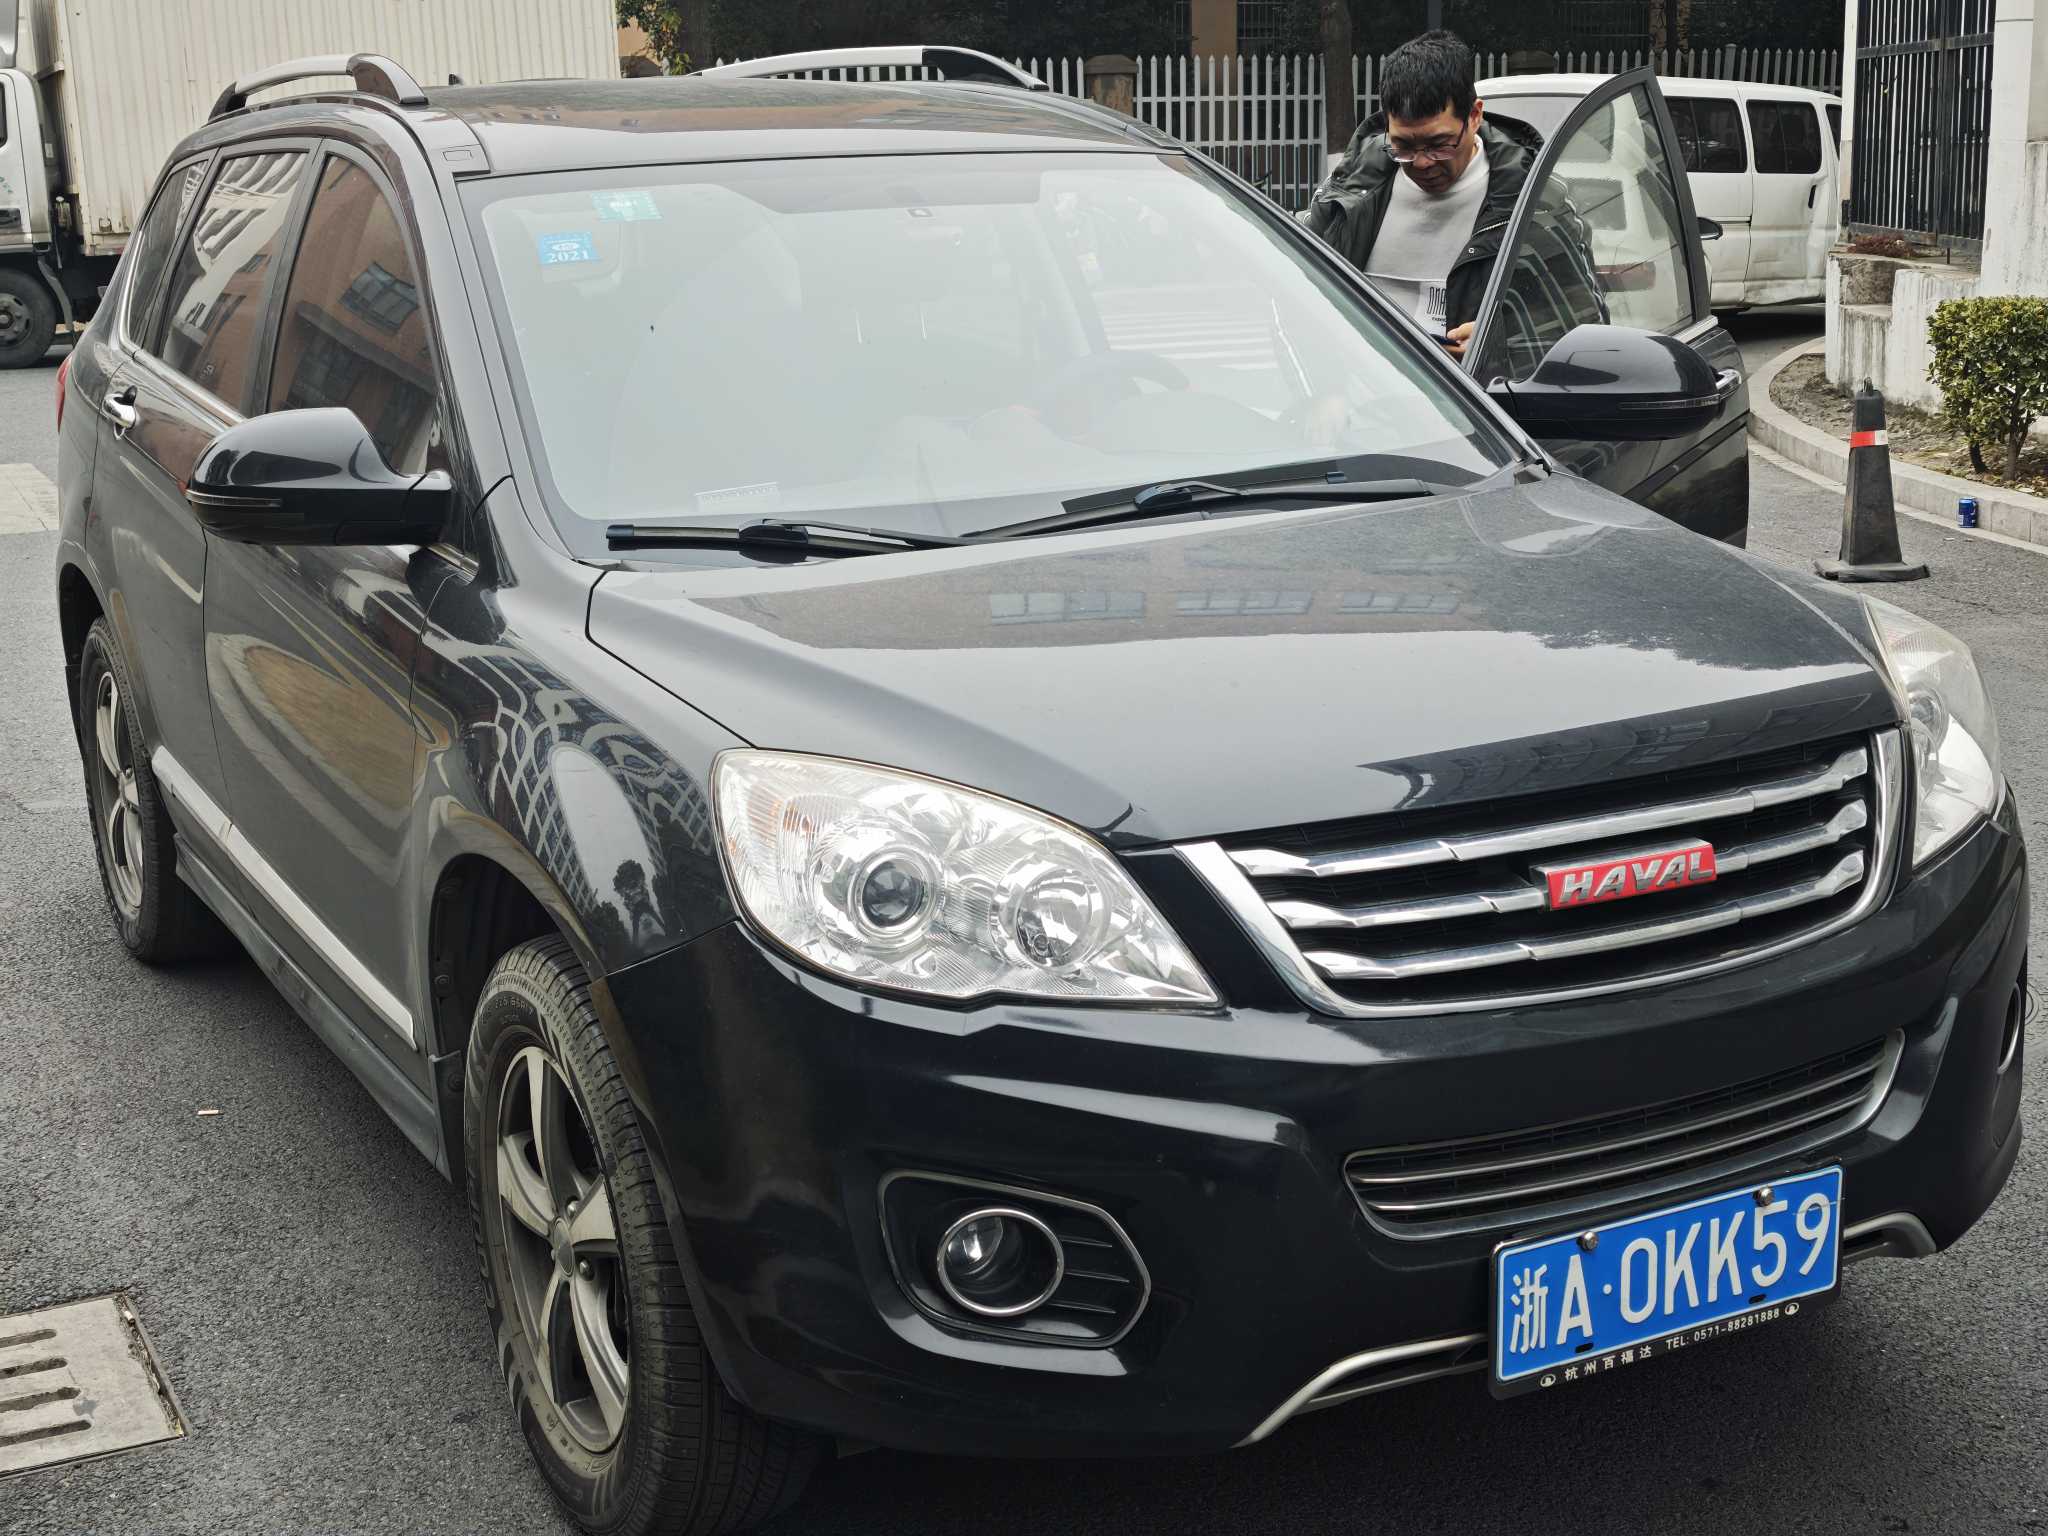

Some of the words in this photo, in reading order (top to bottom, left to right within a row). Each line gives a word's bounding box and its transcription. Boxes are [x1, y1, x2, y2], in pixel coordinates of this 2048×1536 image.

[547, 250, 590, 264] 2021
[1561, 852, 1714, 903] HAVAL
[1565, 1346, 1652, 1380] 杭州百福达
[1693, 1308, 1780, 1341] 0571-88281888
